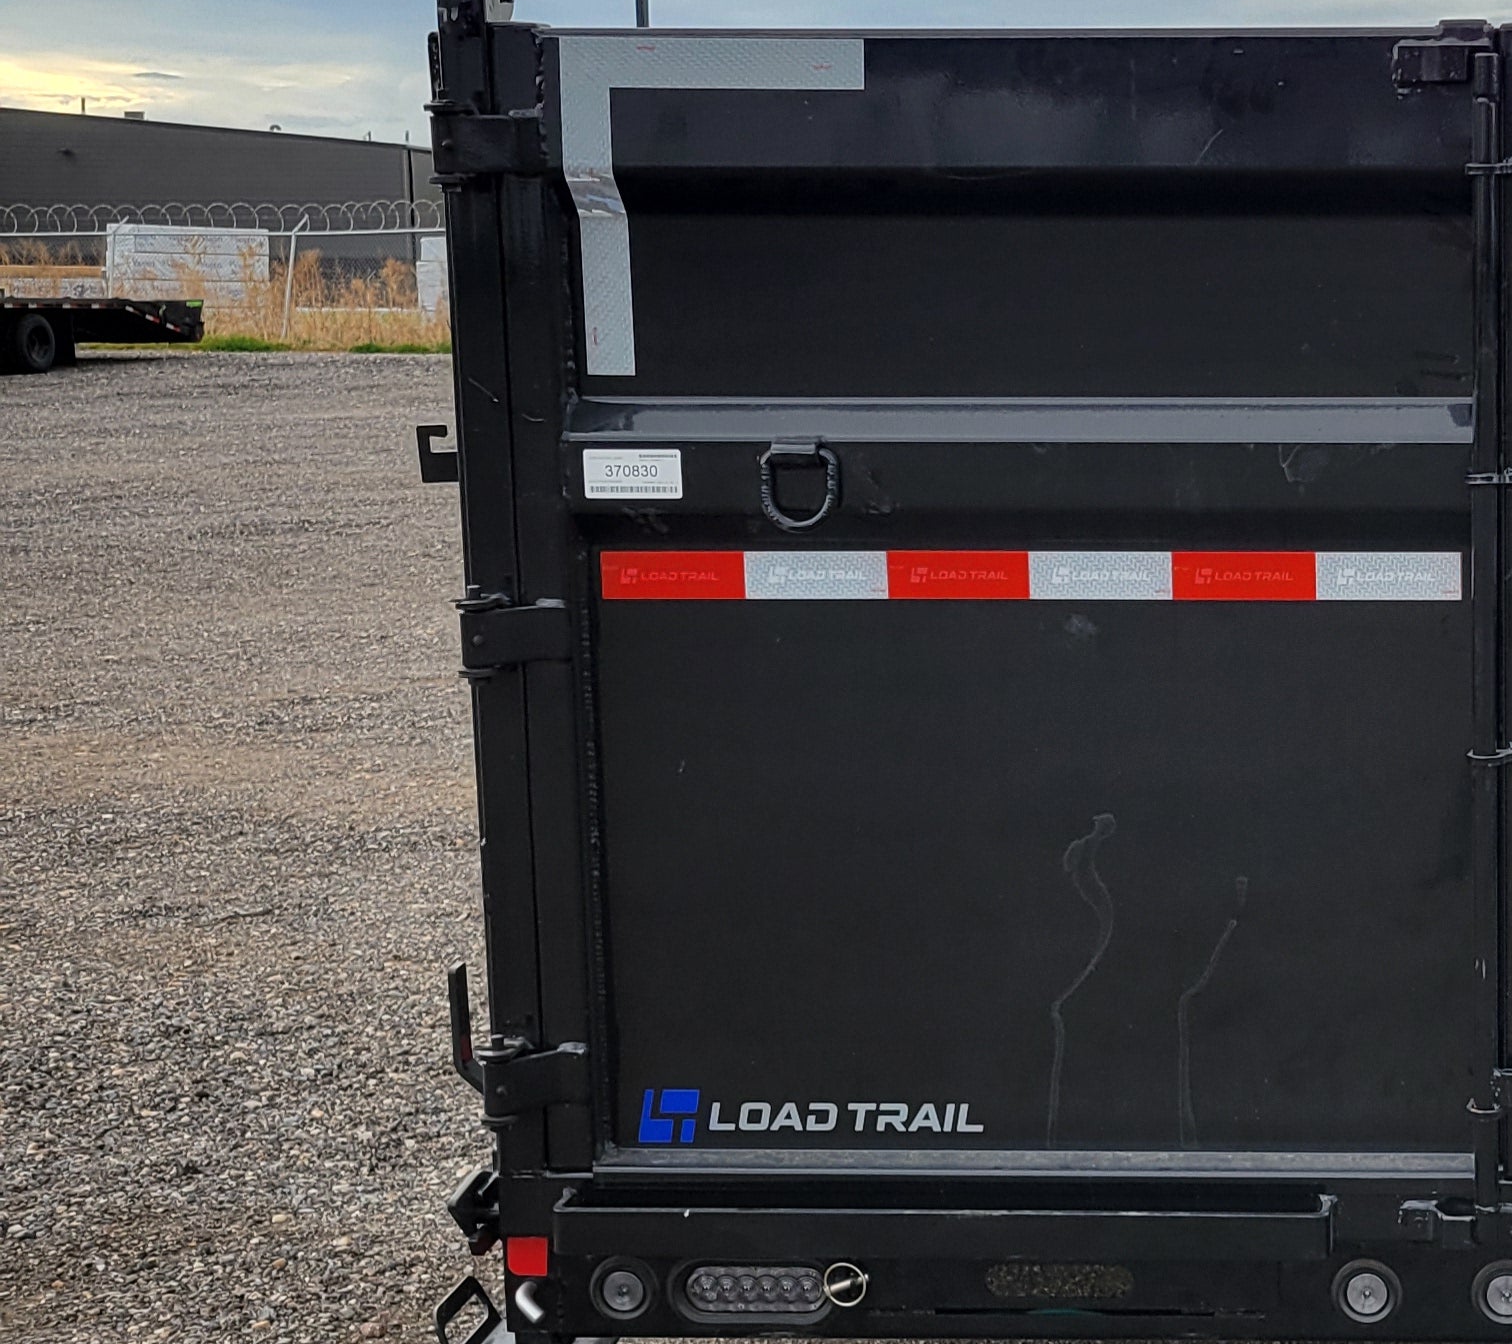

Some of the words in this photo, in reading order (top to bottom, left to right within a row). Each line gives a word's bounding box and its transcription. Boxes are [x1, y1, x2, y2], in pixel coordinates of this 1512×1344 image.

[604, 464, 658, 478] 370830
[708, 1102, 839, 1132] LOAD
[847, 1103, 985, 1133] TRAIL
